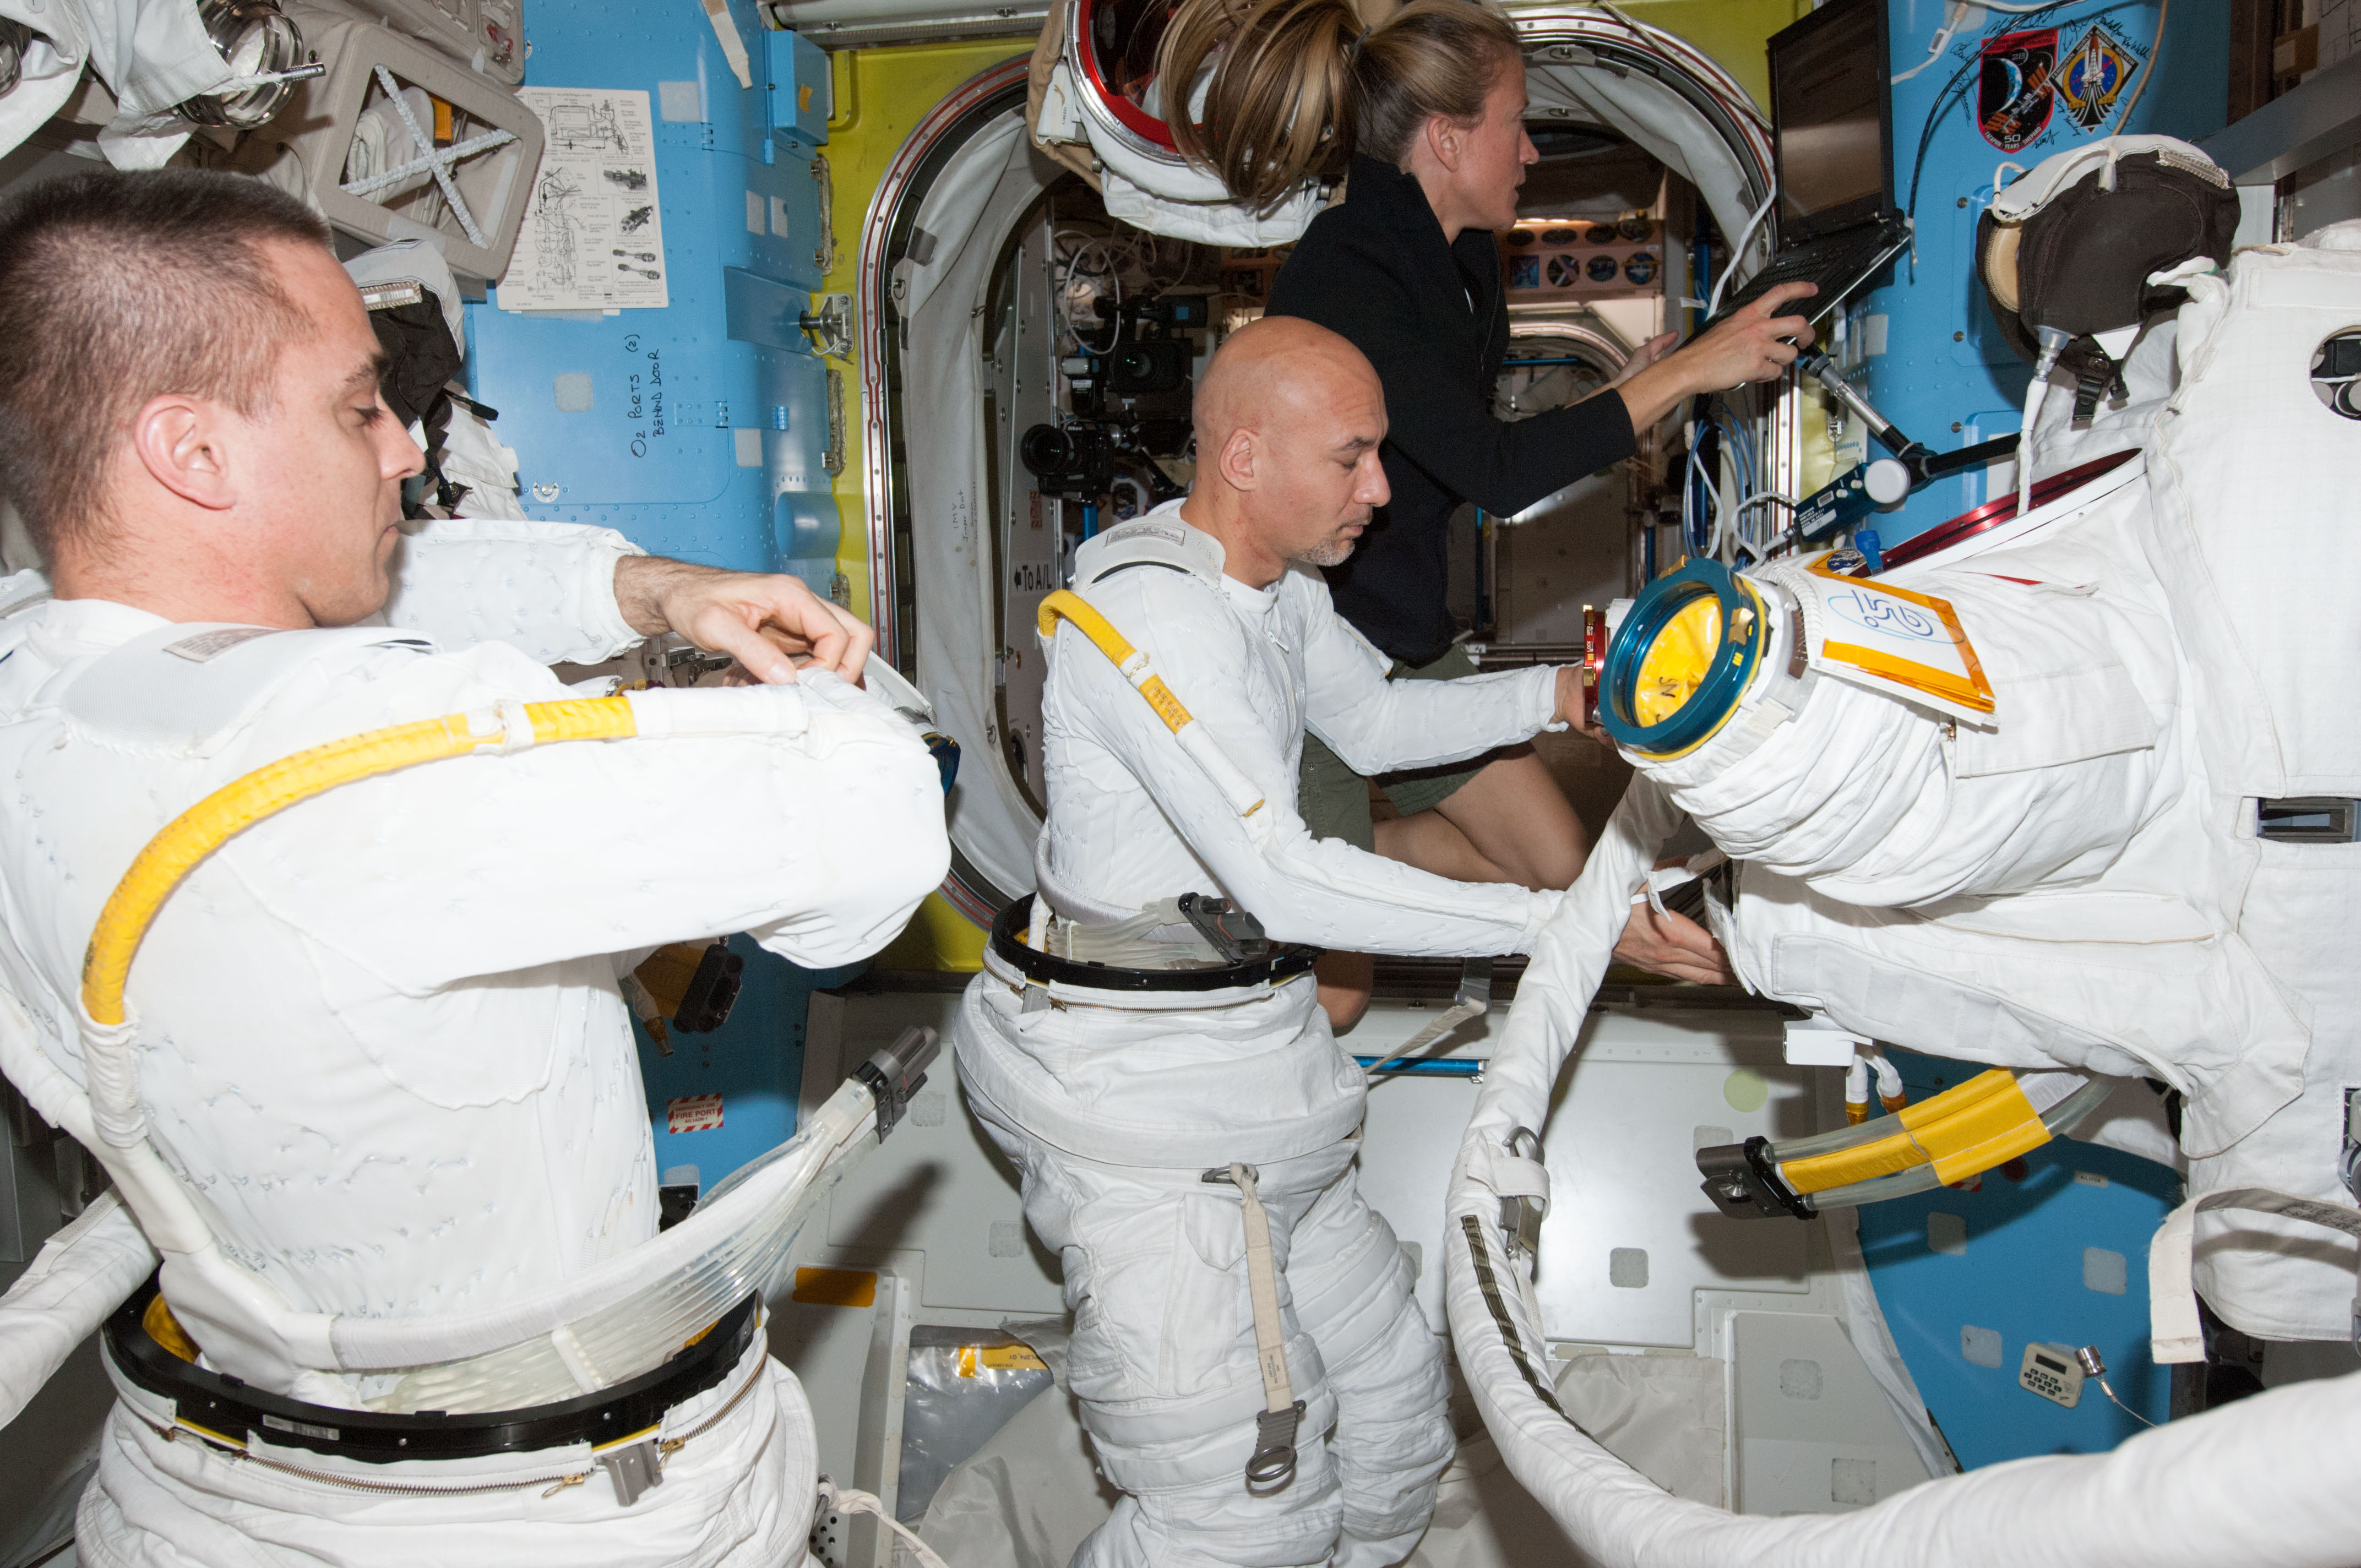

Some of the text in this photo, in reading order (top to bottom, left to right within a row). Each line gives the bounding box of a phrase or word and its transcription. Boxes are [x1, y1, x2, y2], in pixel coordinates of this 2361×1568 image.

[2052, 53, 2075, 79] FERGUSON
[2076, 30, 2093, 51] HURLEY
[2096, 29, 2114, 47] MAGNUS
[2115, 46, 2136, 65] WALHEIM
[2004, 134, 2021, 144] 50
[2022, 126, 2042, 144] SHEPARD
[650, 350, 661, 386] DOOR
[626, 334, 646, 458] O2 PORTS (2)
[1022, 564, 1051, 590] To A/L
[695, 1109, 716, 1117] PORT
